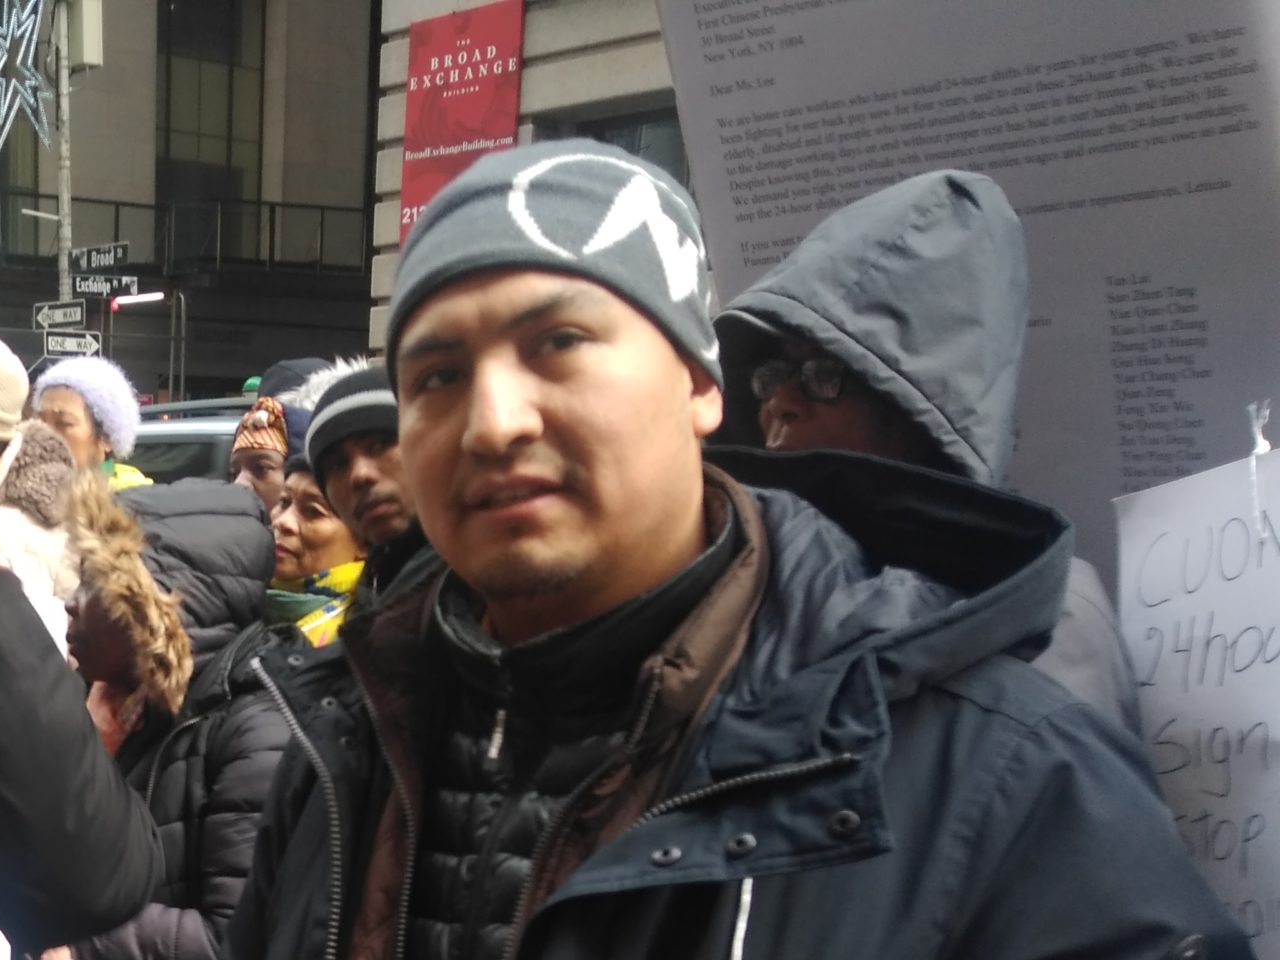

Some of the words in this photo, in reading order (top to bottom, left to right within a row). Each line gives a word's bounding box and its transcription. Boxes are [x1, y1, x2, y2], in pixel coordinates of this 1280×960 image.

[721, 7, 760, 25] Chinese
[430, 45, 497, 72] BROAD
[703, 49, 724, 63] New
[409, 57, 518, 92] EXCHANGE
[442, 84, 480, 98] BUILDING
[709, 81, 732, 95] Dear
[716, 115, 733, 128] We
[752, 108, 780, 123] home
[720, 130, 742, 143] been
[404, 135, 515, 161] BroadExchangeBuilding.com
[761, 137, 801, 154] disabled
[754, 155, 792, 174] damage
[729, 175, 764, 194] Despite
[731, 192, 749, 205] We
[756, 206, 772, 218] the
[750, 240, 769, 253] you
[91, 246, 114, 268] Broad
[75, 276, 111, 298] Exchange
[41, 311, 57, 322] ONE
[62, 309, 79, 320] WAY
[49, 337, 67, 350] ONE
[75, 340, 93, 351] WAY
[1152, 718, 1269, 798] Sign
